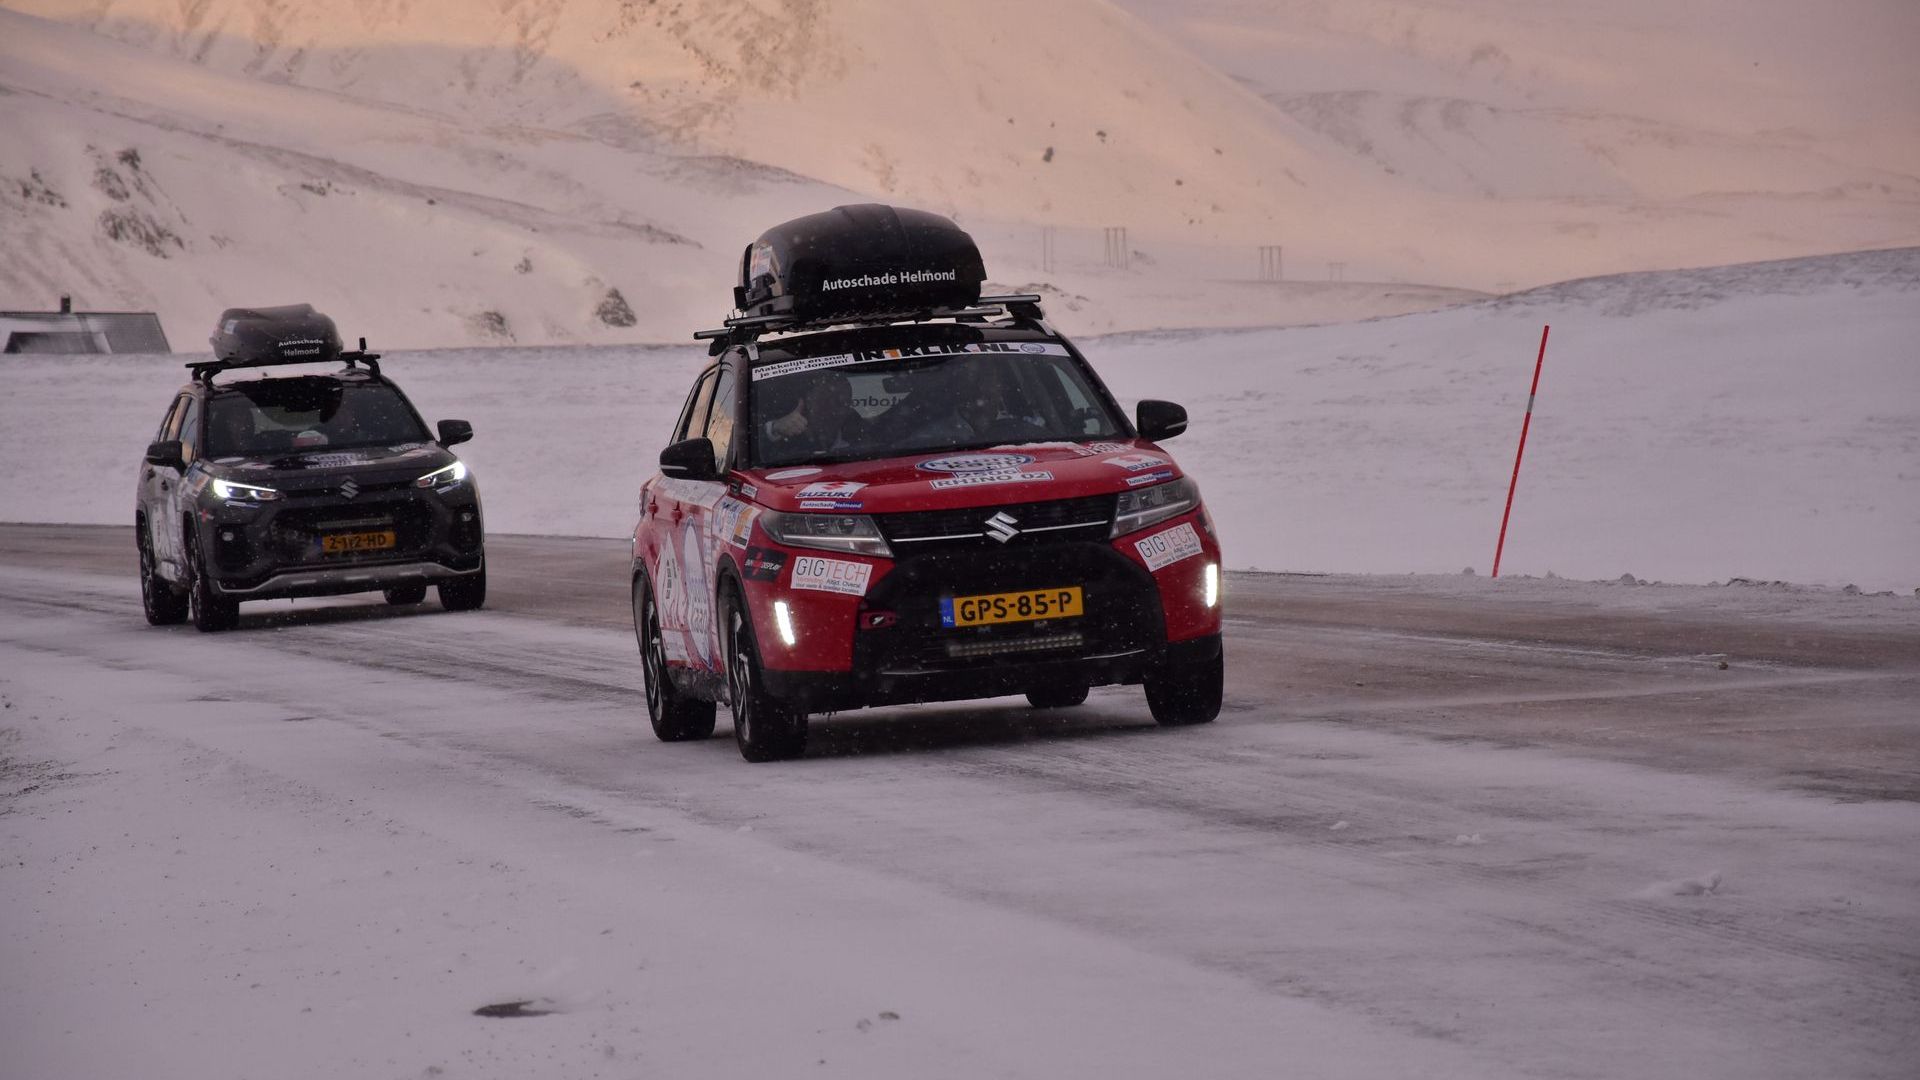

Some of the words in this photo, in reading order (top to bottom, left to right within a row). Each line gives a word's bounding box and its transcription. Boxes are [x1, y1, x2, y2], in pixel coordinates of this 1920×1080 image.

[822, 273, 897, 291] Autoschade
[900, 268, 956, 283] Helmond
[278, 338, 324, 347] Autoschade
[284, 347, 320, 357] Helmond
[754, 360, 806, 374] Makkelijk
[807, 356, 822, 364] en
[760, 371, 771, 379] je
[772, 365, 802, 377] eigen
[937, 475, 1013, 487] RHINO
[1139, 524, 1197, 558] GIGTECH
[796, 558, 869, 582] GIGTECH
[961, 591, 1072, 621] GPS-85-P
